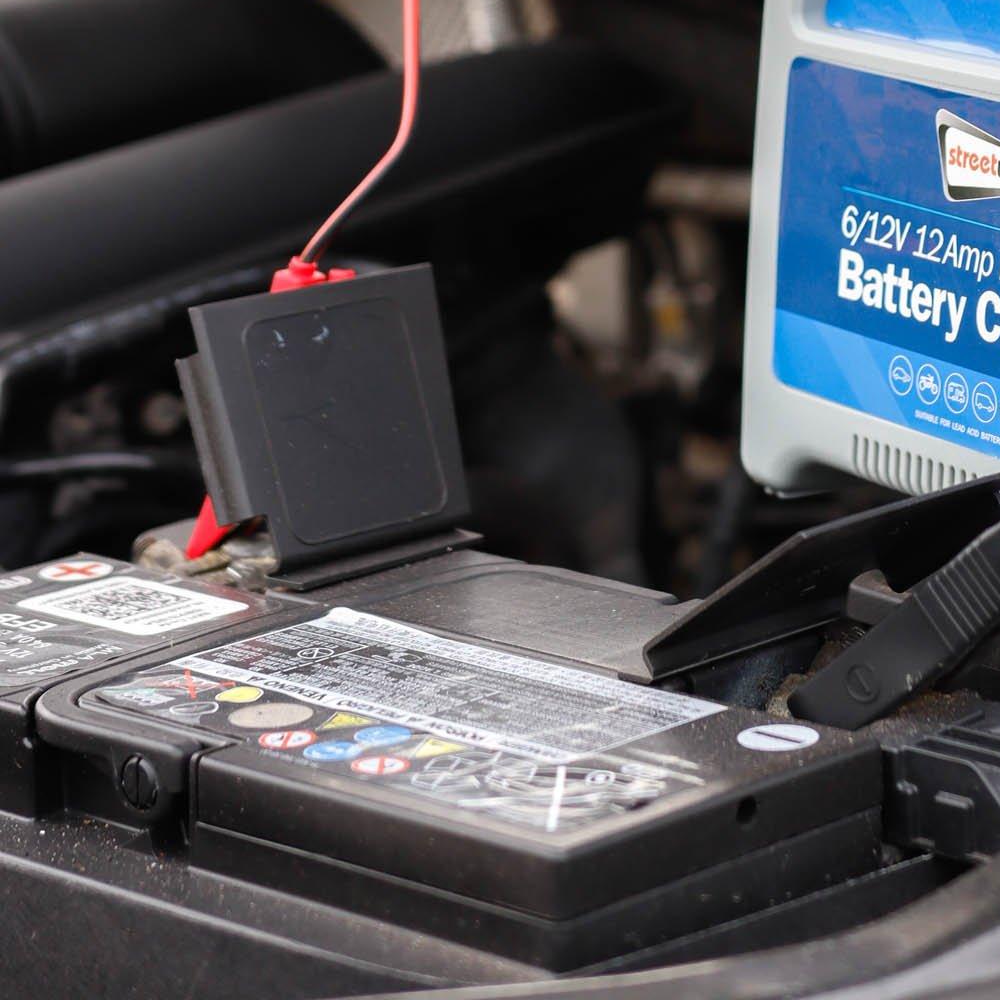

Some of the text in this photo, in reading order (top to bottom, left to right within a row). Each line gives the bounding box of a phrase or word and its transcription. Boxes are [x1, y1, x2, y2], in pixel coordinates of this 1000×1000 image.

[841, 205, 912, 251] 6/12V
[912, 224, 995, 282] 12Amp
[837, 248, 968, 343] Battery
[939, 417, 951, 428] FOR
[951, 421, 966, 433] LEAD
[966, 426, 980, 438] ACID
[262, 677, 327, 702] VENENO
